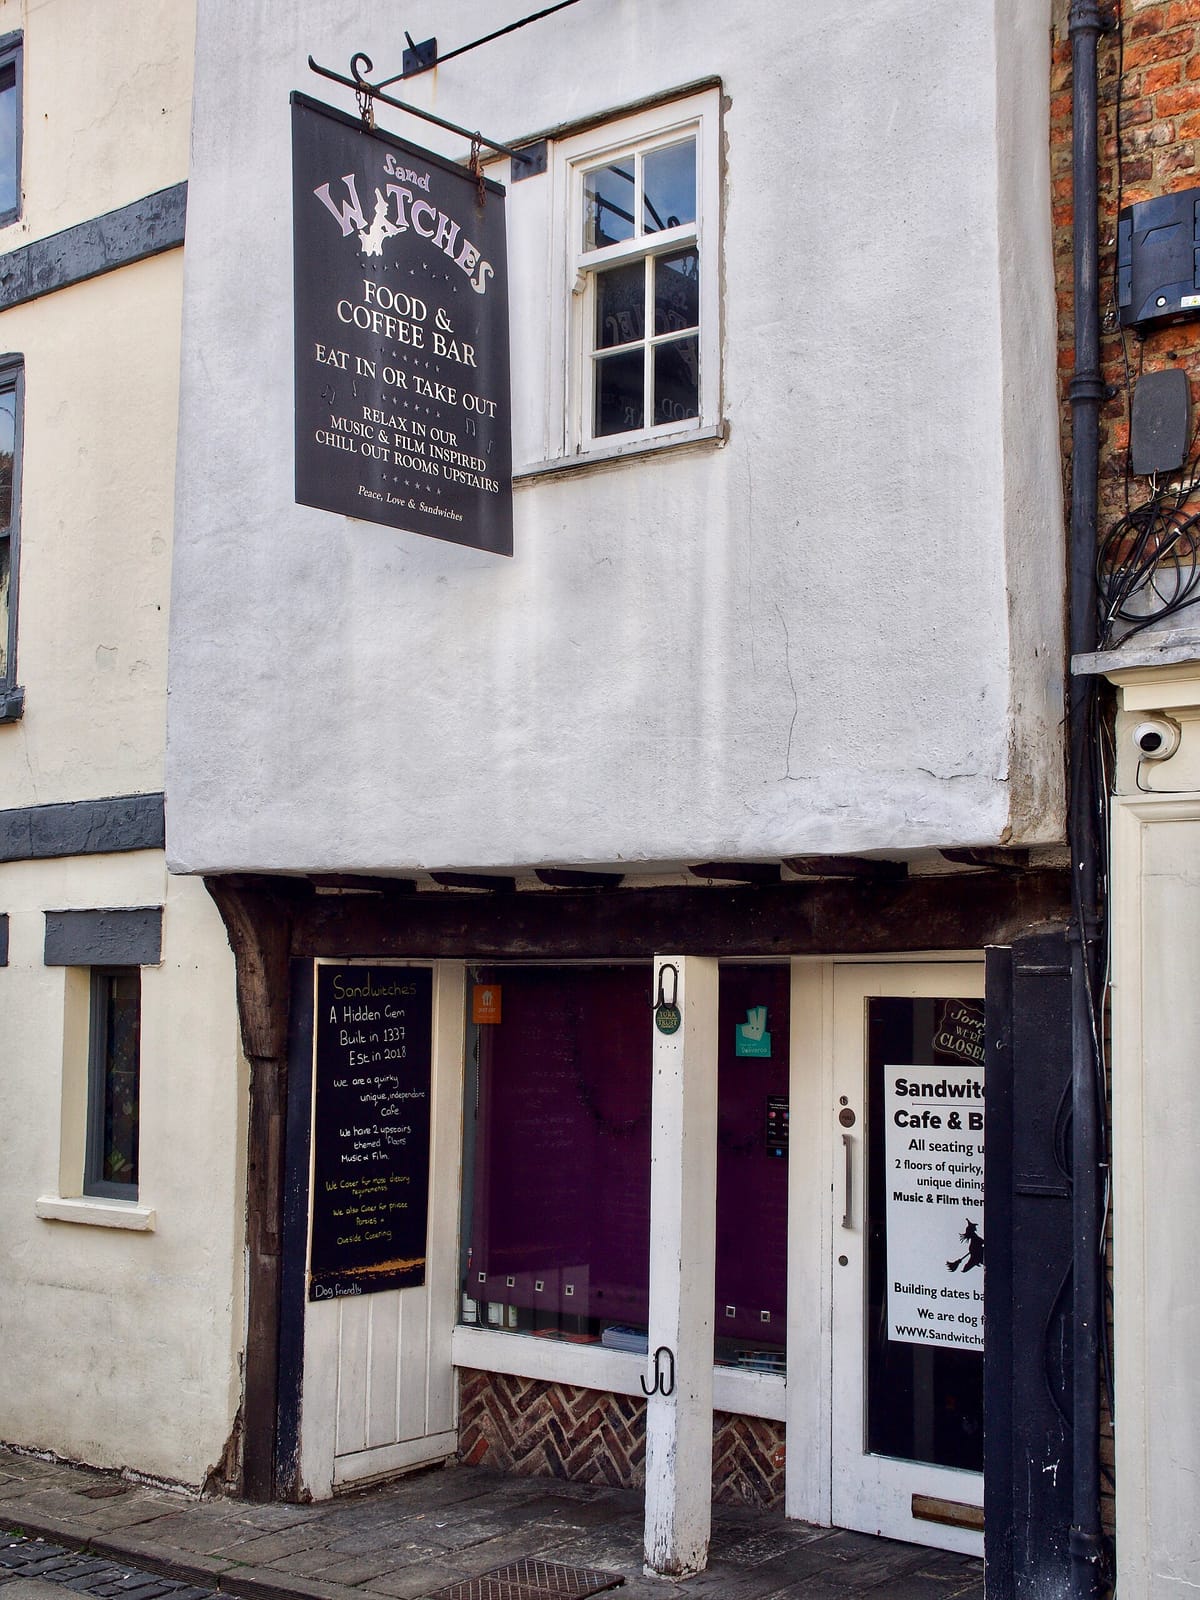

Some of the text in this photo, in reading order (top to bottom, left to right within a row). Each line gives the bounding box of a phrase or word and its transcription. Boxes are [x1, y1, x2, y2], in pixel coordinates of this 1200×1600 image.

[384, 153, 430, 192] Sand
[363, 280, 454, 333] FOOD &
[337, 300, 477, 368] COFFEE BAR
[315, 343, 497, 418] EAT IN OR TAKE OUT
[363, 406, 458, 447] RELAX IN OUR
[330, 415, 486, 472] MUSIC & FILM INSPIRED
[315, 429, 499, 494] CHILL OUT ROOMS UPSTAIRS
[358, 485, 463, 522] Peace, Love & Sandwiches
[329, 1005, 405, 1024] A Hidden Gem
[340, 1027, 406, 1046] Built in 1337
[350, 1046, 407, 1066] Est in 2018
[352, 1078, 365, 1086] are
[374, 1074, 398, 1089] quirky
[894, 1110, 942, 1128] Cafe
[947, 1112, 962, 1130] &
[340, 1125, 411, 1139] We have 2 upstairs
[354, 1138, 381, 1150] themed
[909, 1139, 925, 1150] All
[929, 1141, 973, 1156] seating
[341, 1155, 362, 1163] Music
[895, 1159, 983, 1176] 2 floors of quirky,
[389, 1172, 410, 1184] dietary
[917, 1177, 951, 1189] unique
[893, 1192, 923, 1202] Music
[926, 1194, 934, 1203] &
[936, 1194, 959, 1205] Film
[315, 1284, 333, 1298] Dog
[894, 1282, 937, 1299] Building
[940, 1287, 970, 1299] dates
[917, 1308, 934, 1319] We
[937, 1313, 954, 1321] are
[958, 1313, 977, 1327] dog
